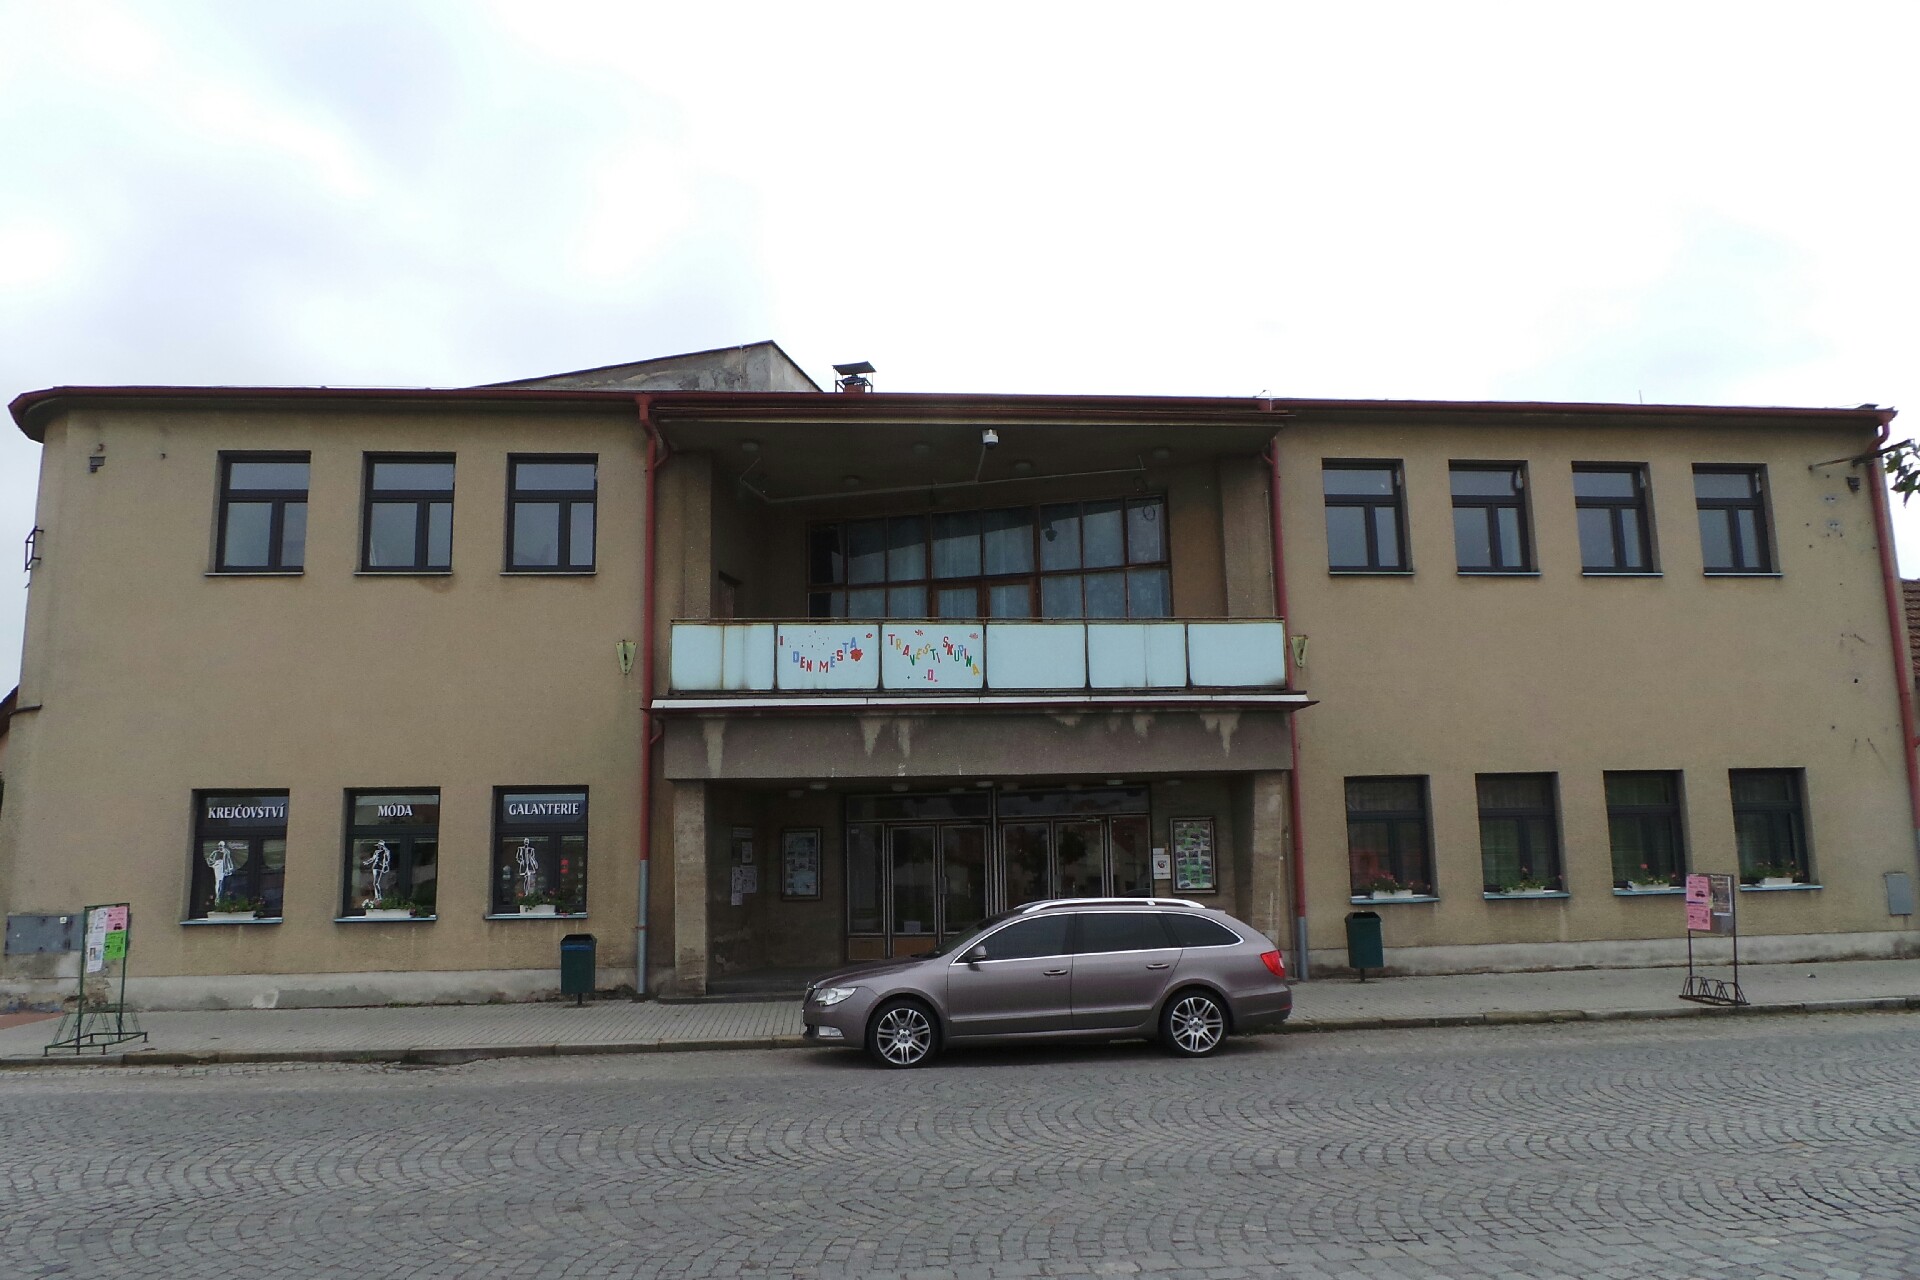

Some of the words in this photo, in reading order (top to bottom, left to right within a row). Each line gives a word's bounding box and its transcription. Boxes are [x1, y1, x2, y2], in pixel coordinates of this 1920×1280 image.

[792, 651, 813, 673] DEN
[888, 634, 941, 666] TRAVESTI
[943, 636, 980, 676] SKUPINA
[207, 803, 286, 819] KREJČOVSTVÍ
[377, 803, 413, 817] MÓDA
[508, 803, 580, 815] GALANTERIE
